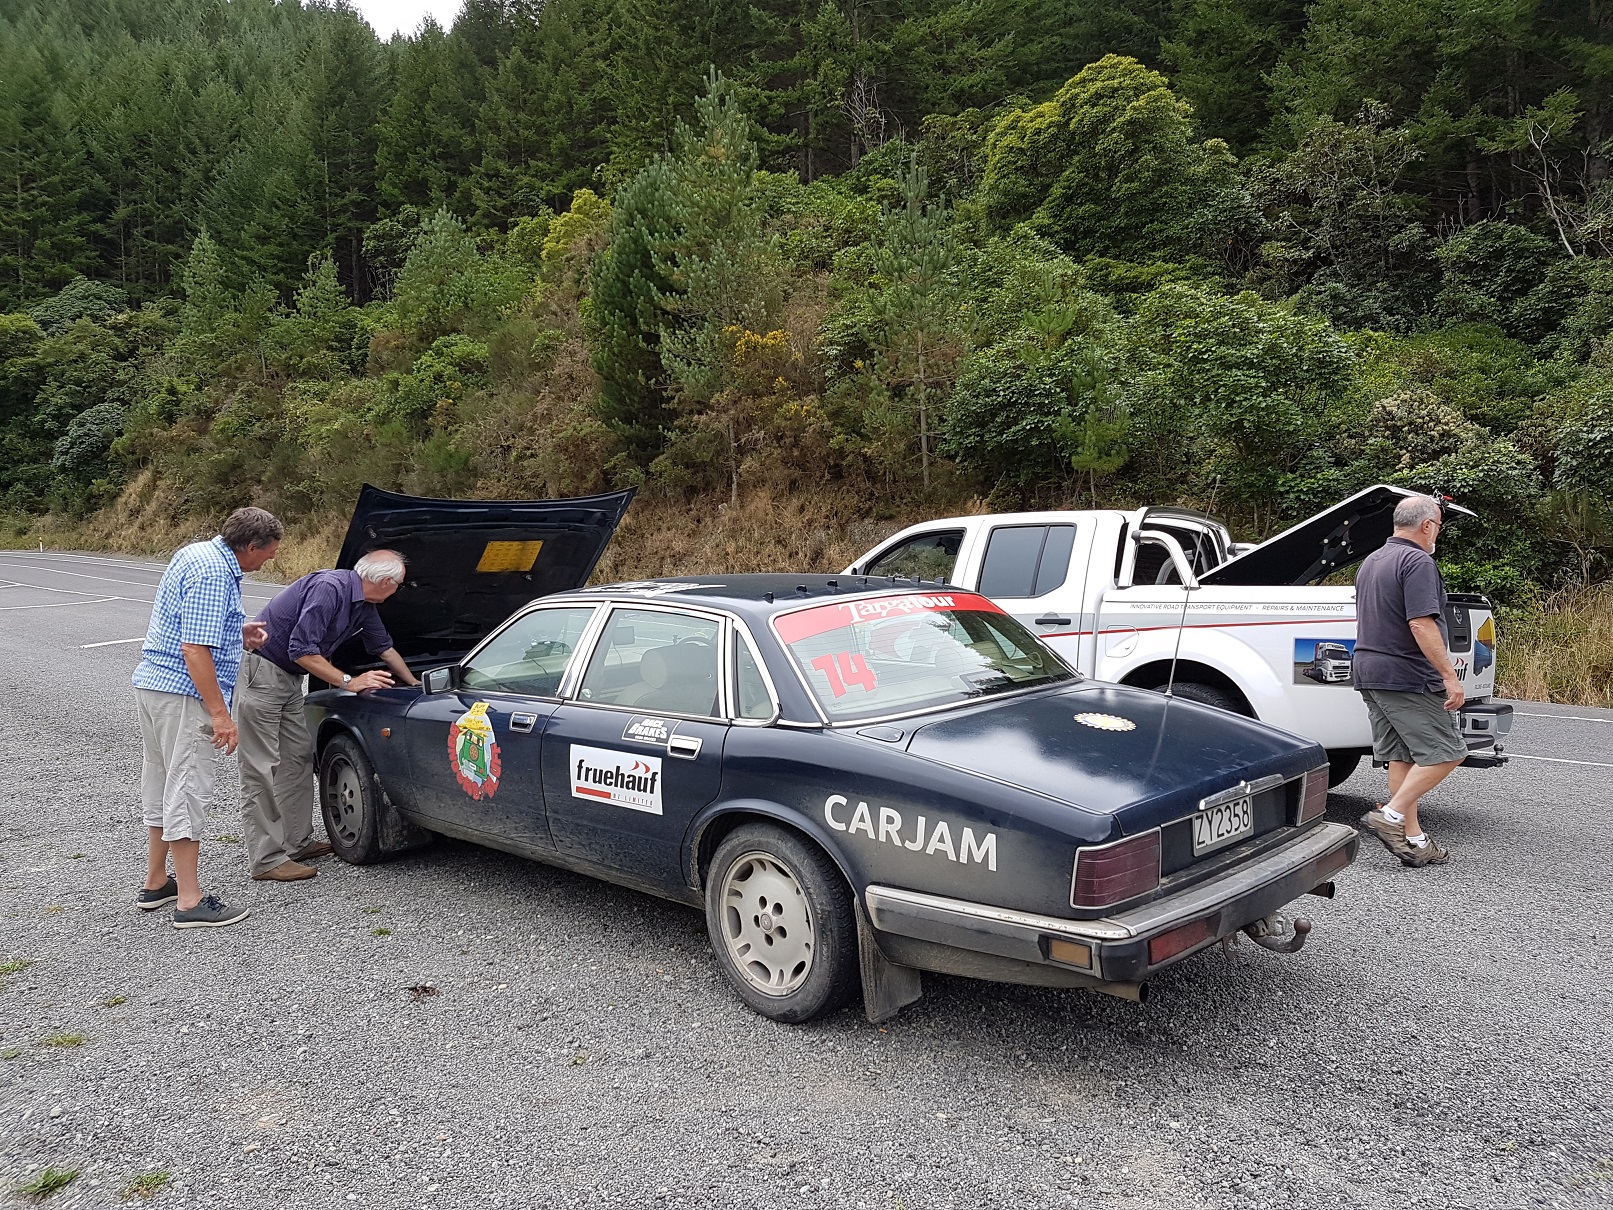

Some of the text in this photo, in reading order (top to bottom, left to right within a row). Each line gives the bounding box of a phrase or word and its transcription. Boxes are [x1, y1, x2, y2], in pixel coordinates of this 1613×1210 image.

[811, 651, 877, 698] 14
[628, 722, 668, 739] BRAKES
[576, 759, 658, 795] fruehauf
[624, 795, 653, 806] LIMITED
[824, 794, 997, 872] CARJAM
[1195, 799, 1249, 846] ZY2358
